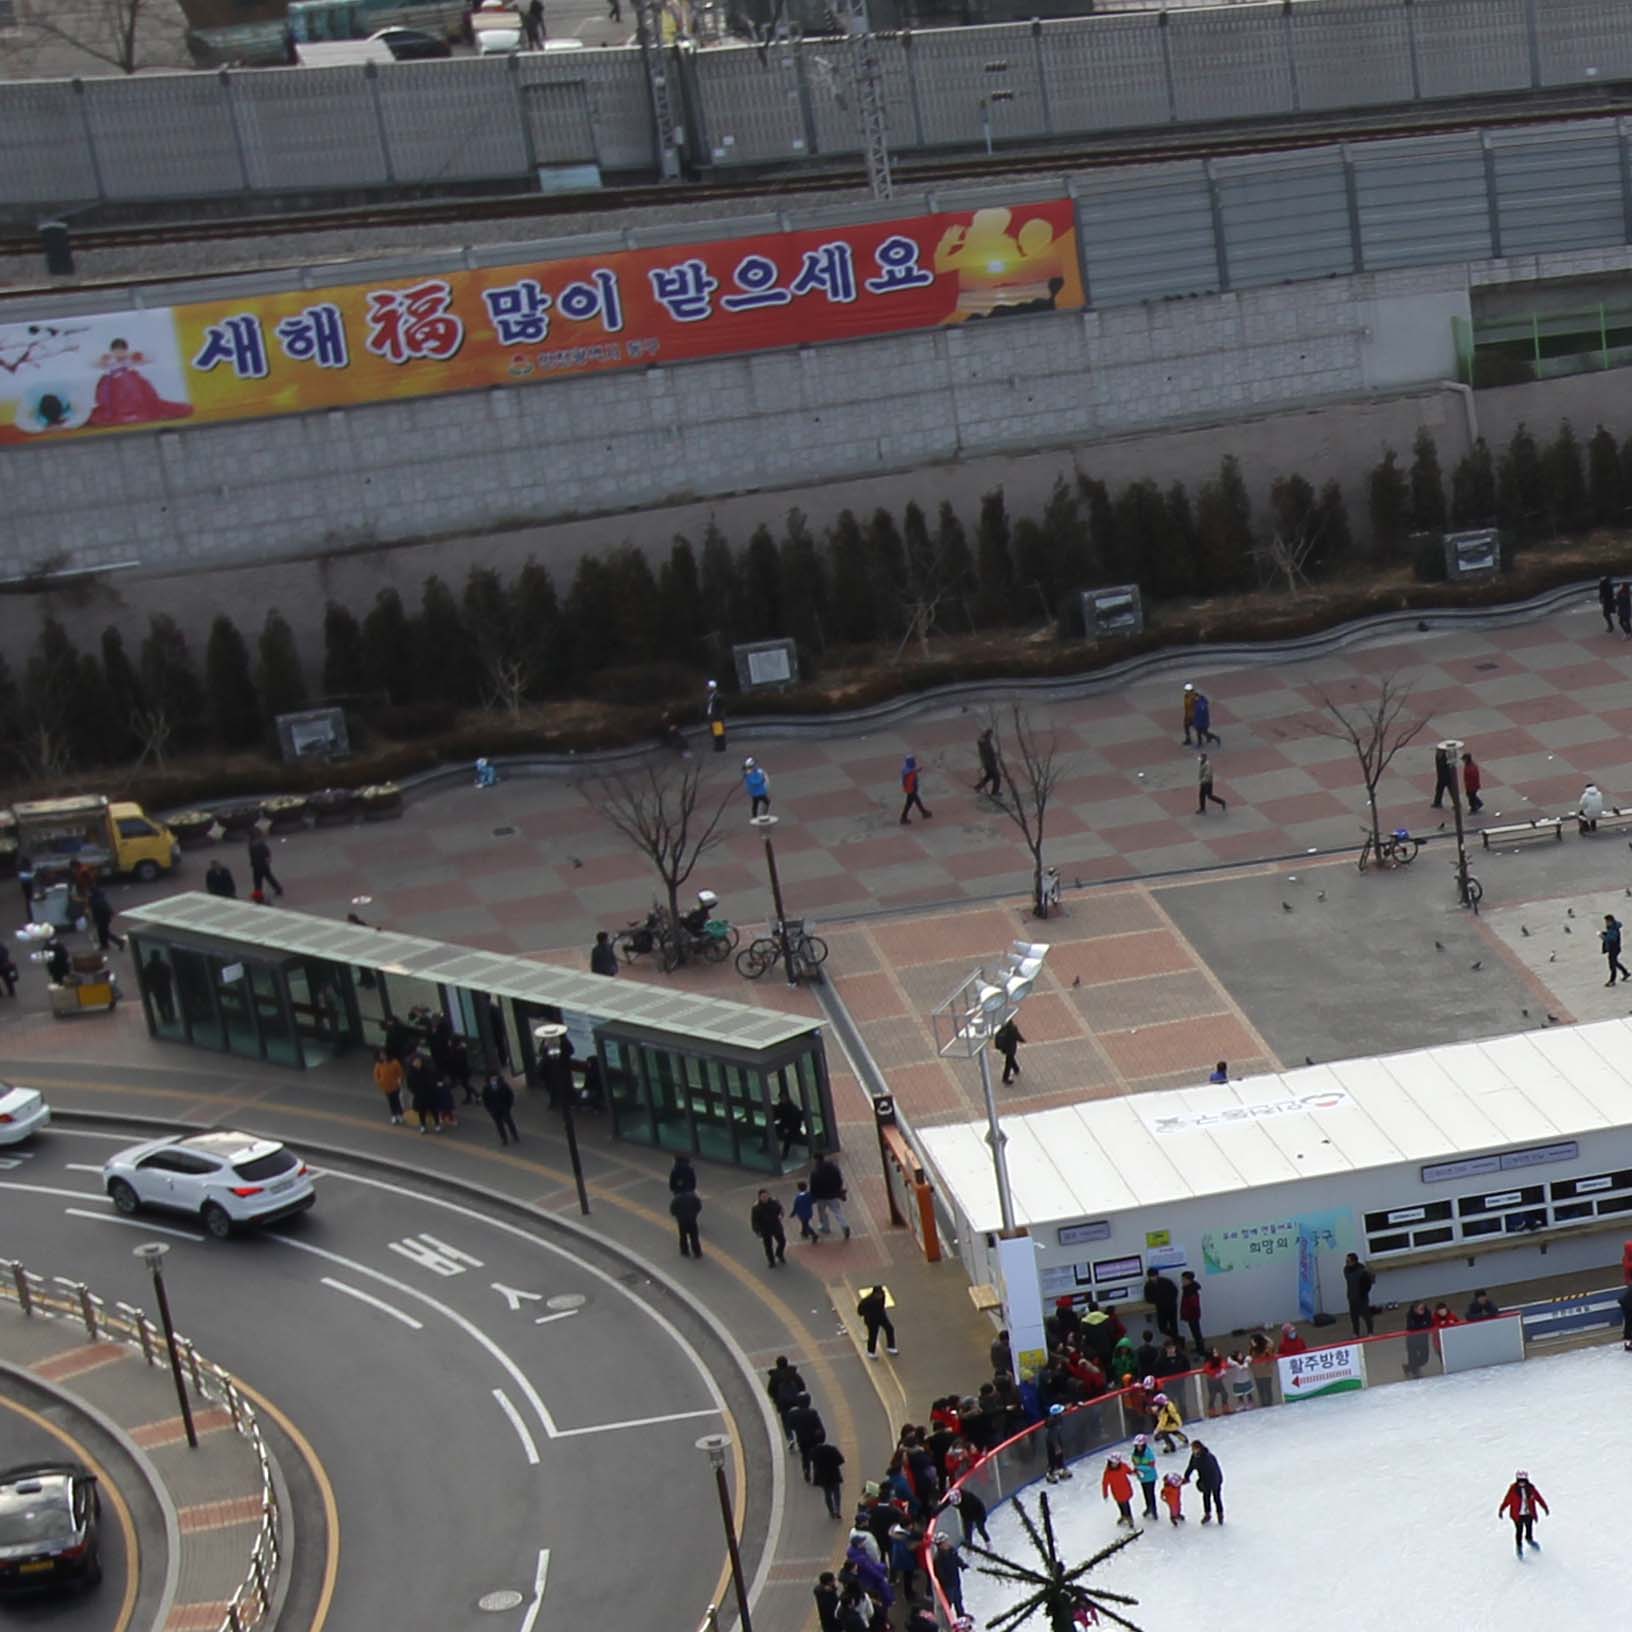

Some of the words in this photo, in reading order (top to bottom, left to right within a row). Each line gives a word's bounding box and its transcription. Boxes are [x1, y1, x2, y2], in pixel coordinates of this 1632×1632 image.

[194, 303, 348, 377] 새해
[366, 281, 463, 364] 福
[483, 270, 622, 344] 많이
[650, 235, 934, 322] 받으세요
[1250, 1237, 1289, 1255] 희망의
[1289, 1348, 1350, 1375] 활주방향
